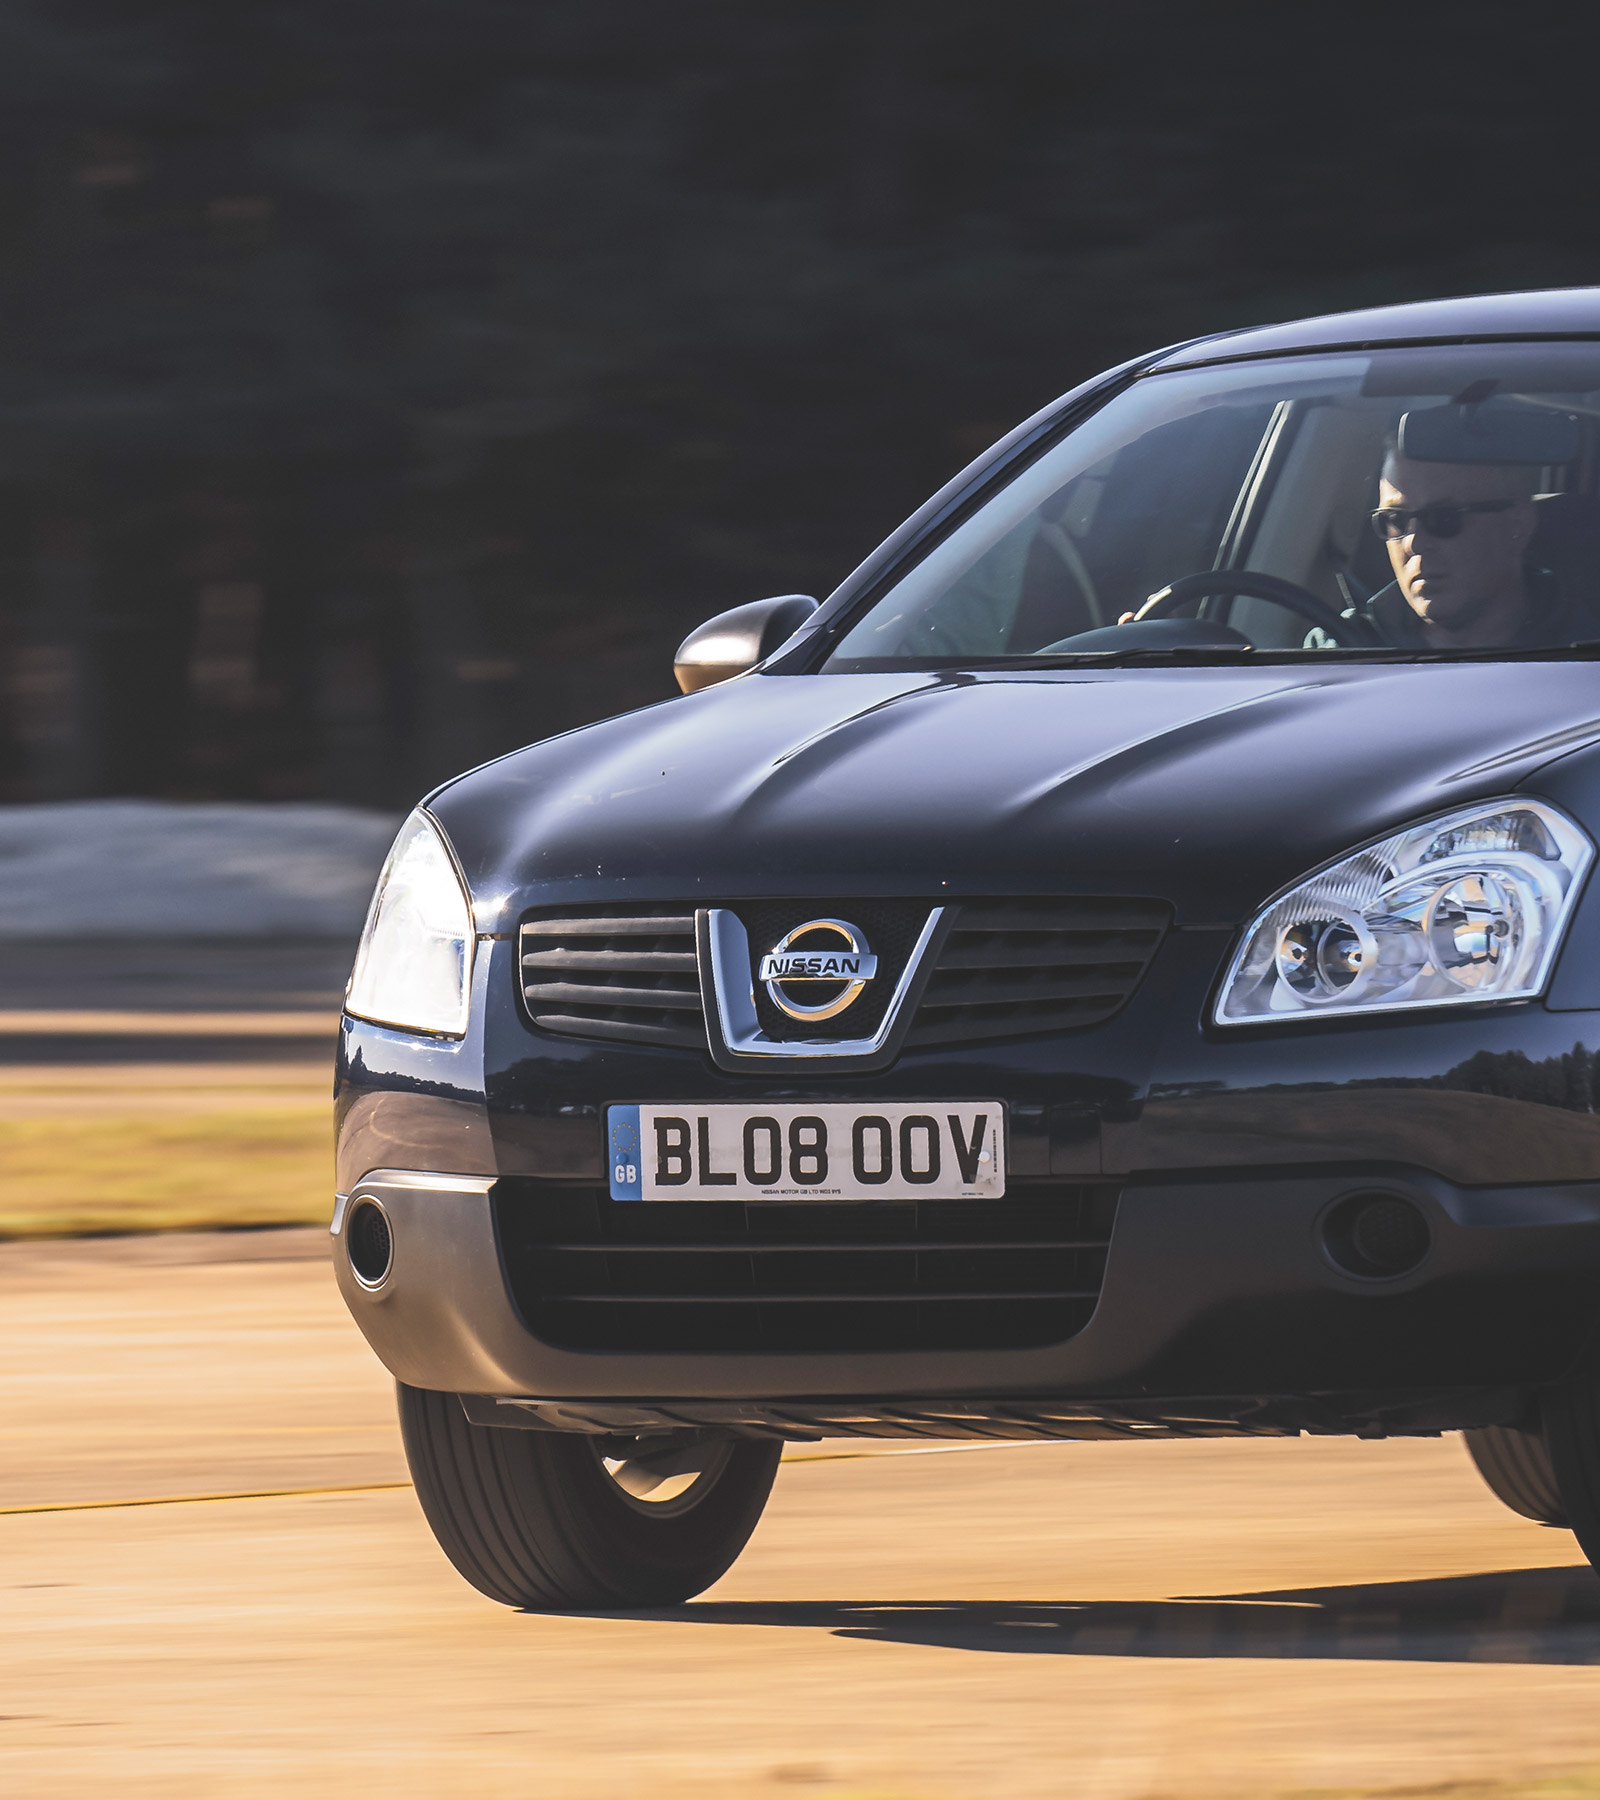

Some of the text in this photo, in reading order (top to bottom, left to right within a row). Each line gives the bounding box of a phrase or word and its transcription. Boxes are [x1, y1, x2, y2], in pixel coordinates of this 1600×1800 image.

[768, 958, 861, 974] NISSAN
[653, 1114, 829, 1186] BL08
[614, 1164, 637, 1184] GB
